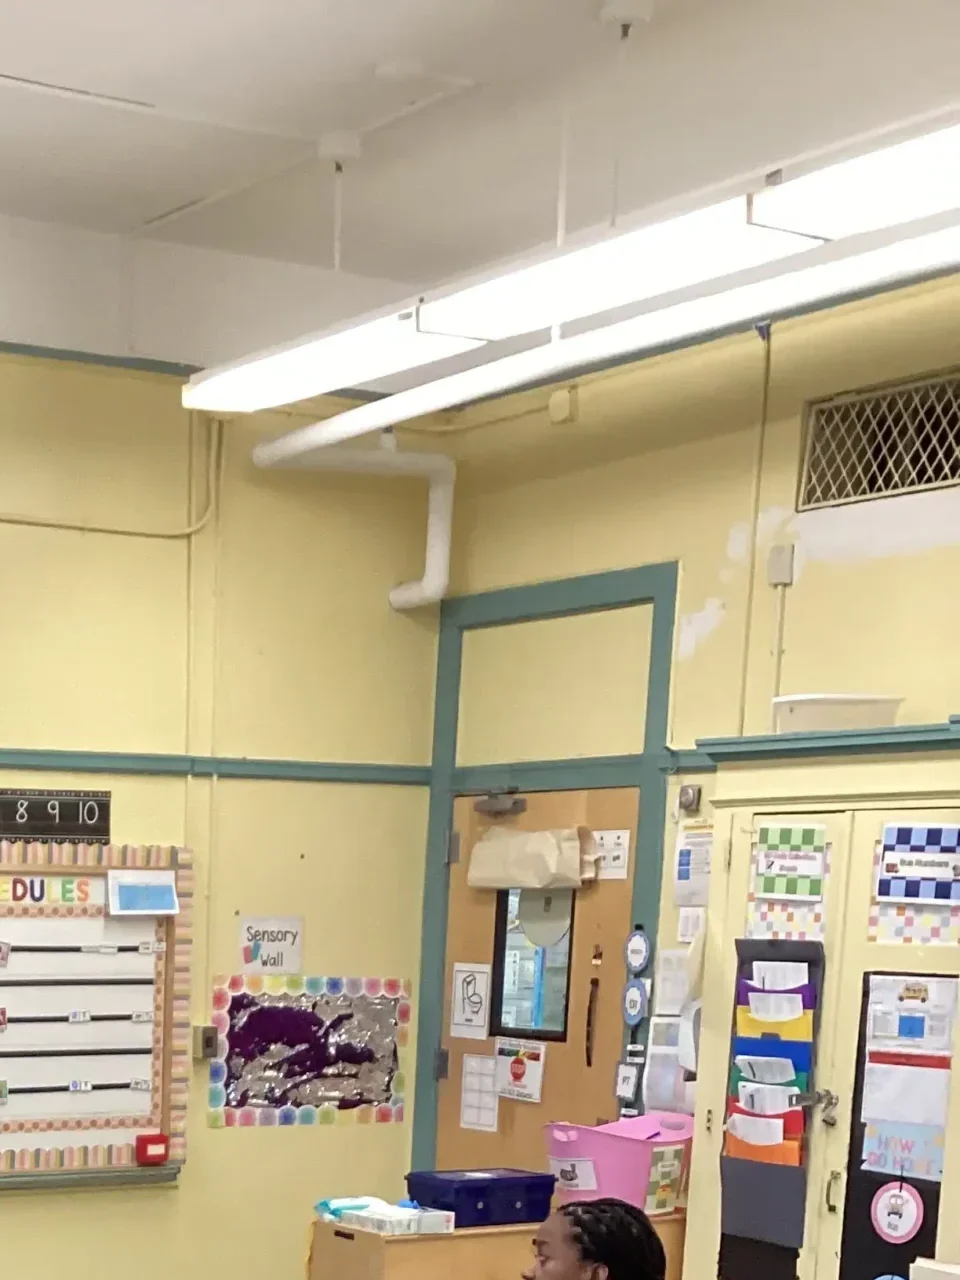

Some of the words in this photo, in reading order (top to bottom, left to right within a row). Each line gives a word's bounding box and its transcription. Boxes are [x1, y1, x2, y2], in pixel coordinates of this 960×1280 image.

[15, 798, 28, 822] 8
[47, 799, 60, 822] 9
[78, 800, 99, 824] 10
[246, 926, 298, 946] Sensory
